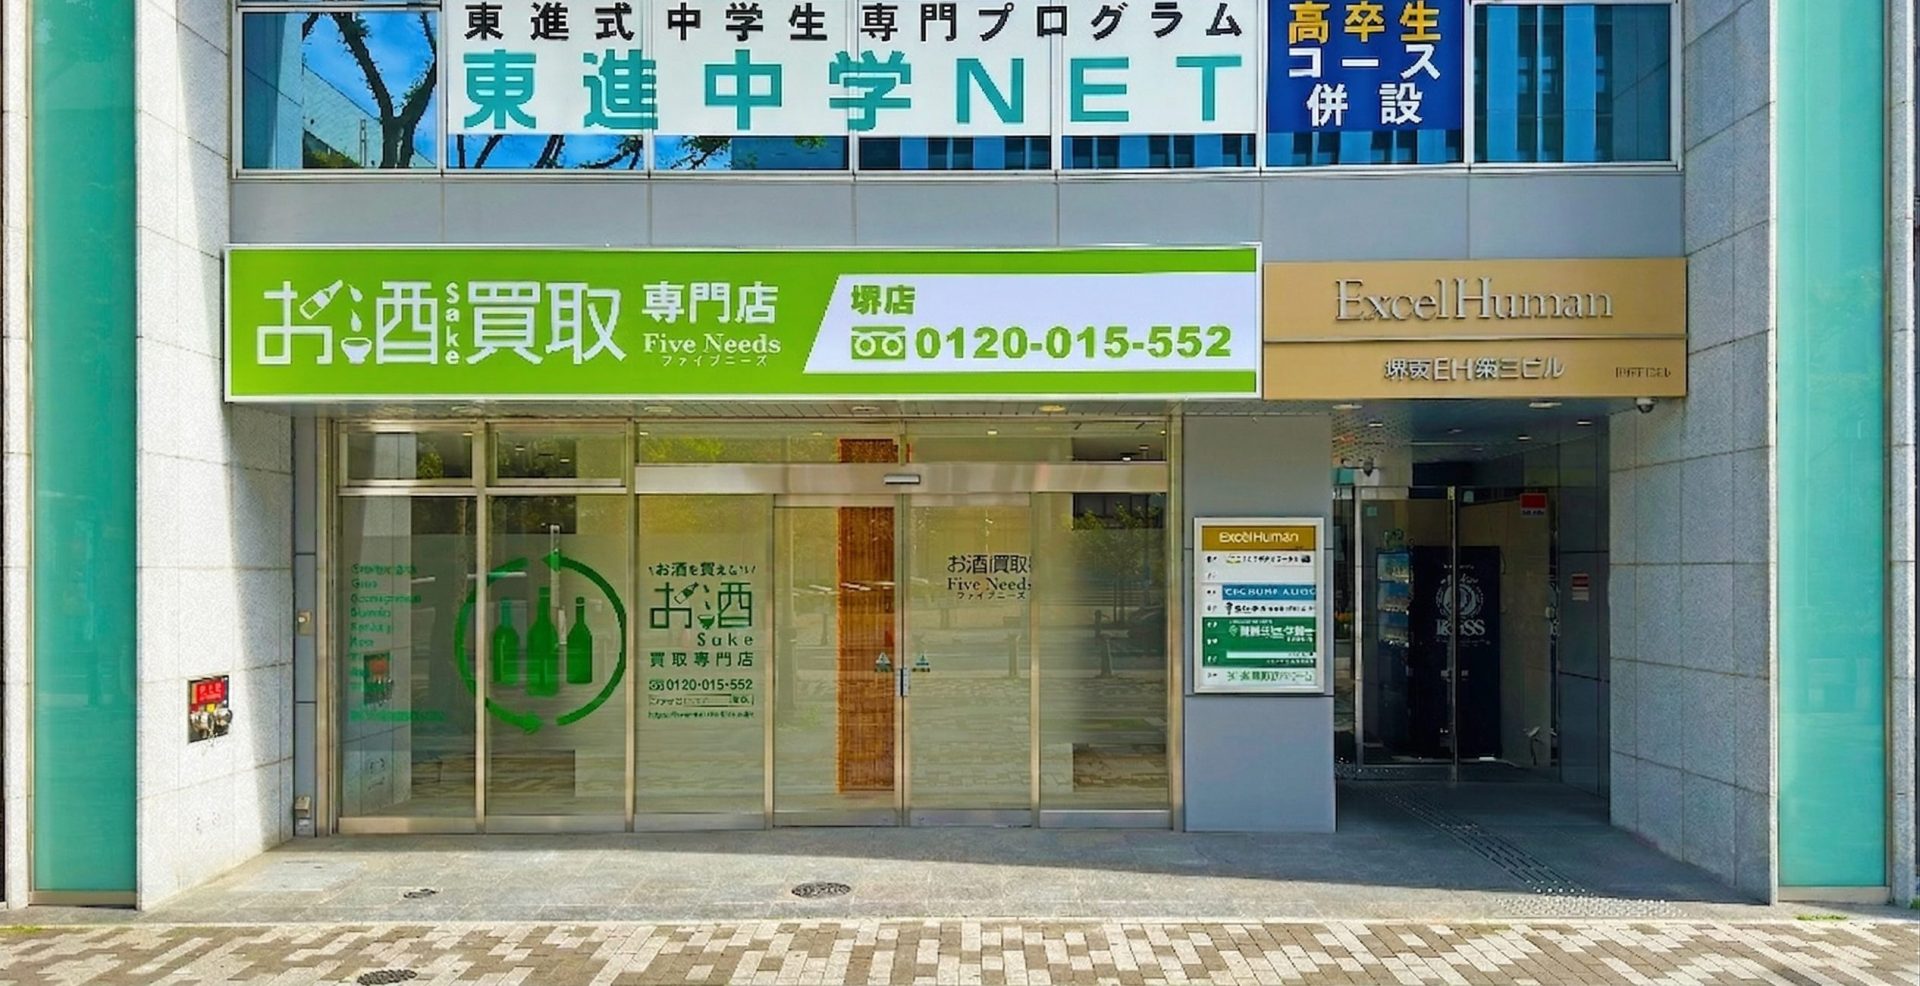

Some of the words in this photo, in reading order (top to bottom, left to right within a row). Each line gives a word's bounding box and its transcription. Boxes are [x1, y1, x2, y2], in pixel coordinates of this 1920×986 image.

[464, 2, 1243, 42] 東進式中学生専門プログラム
[1287, 0, 1441, 44] 高卒生
[1288, 45, 1441, 79] コース
[1306, 84, 1424, 126] 併設
[641, 280, 779, 324] 専門店
[851, 283, 916, 316] 堺店
[1335, 276, 1615, 323] ExcelHuman
[643, 333, 697, 353] Five
[703, 332, 782, 354] Needs
[915, 325, 1233, 360] 0120-015-552
[946, 554, 1032, 575] お酒買取
[947, 577, 981, 591] Five
[697, 632, 754, 647] Sake
[649, 651, 754, 668] 買取専門店
